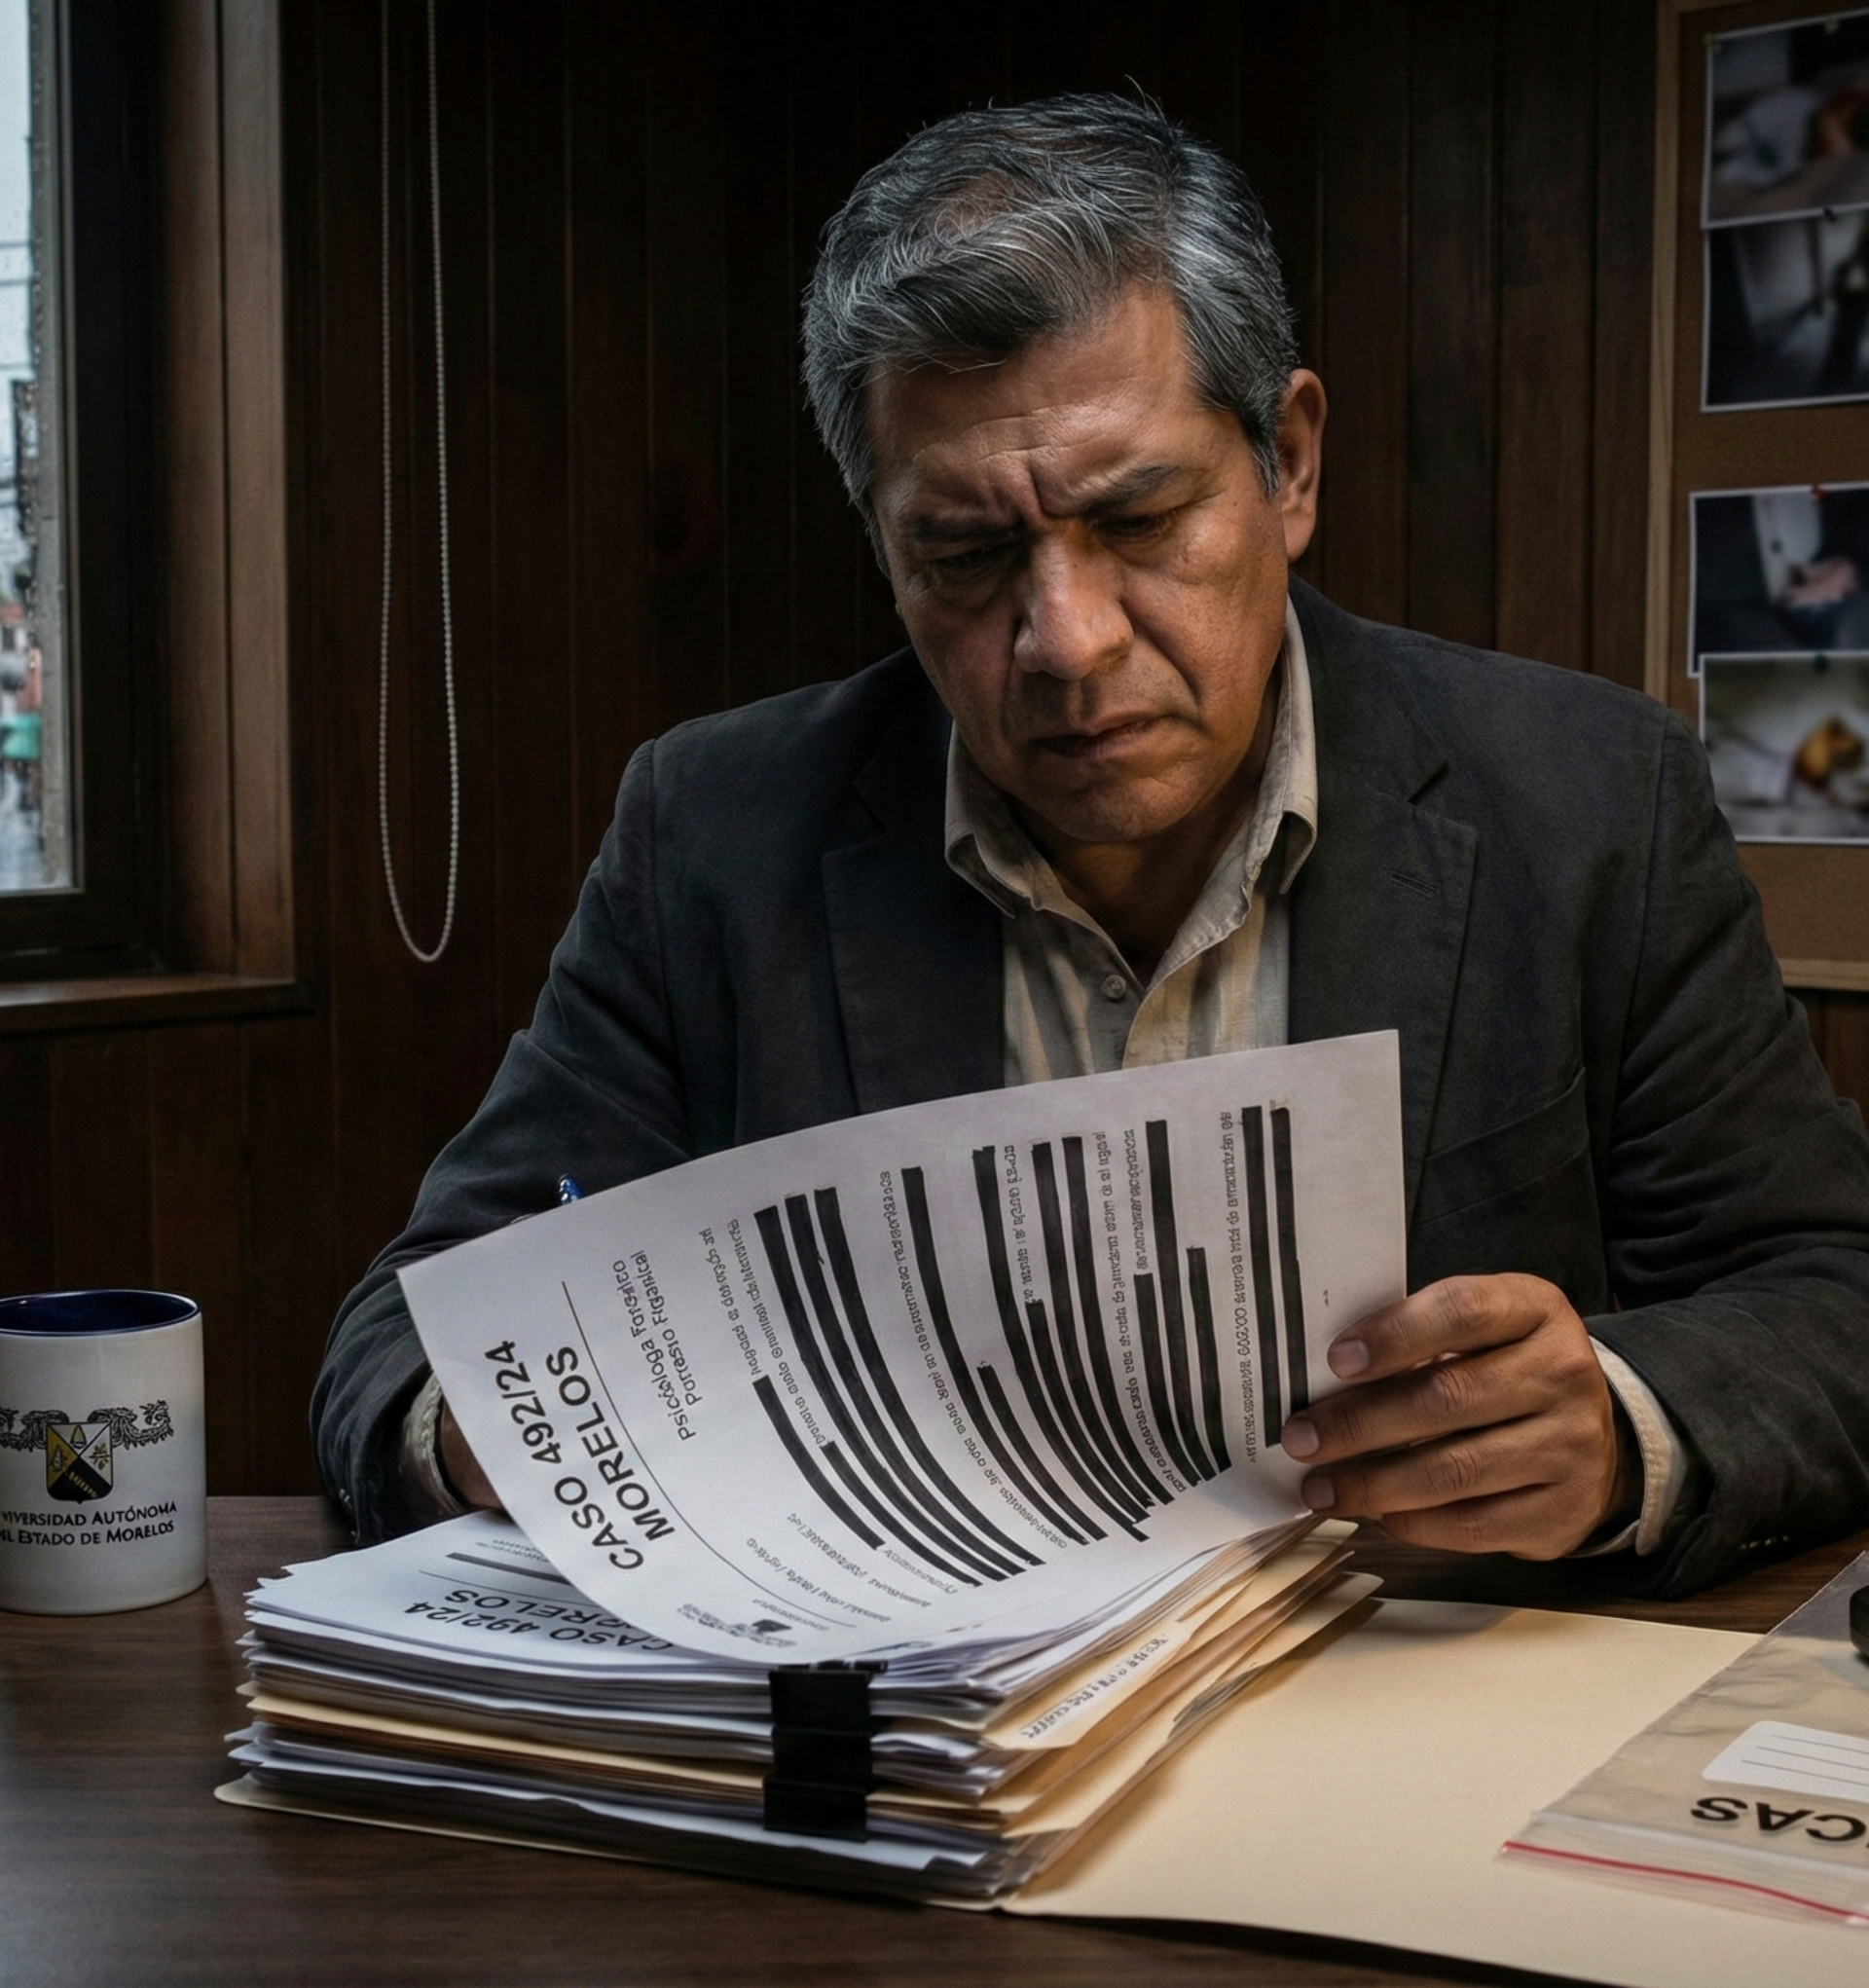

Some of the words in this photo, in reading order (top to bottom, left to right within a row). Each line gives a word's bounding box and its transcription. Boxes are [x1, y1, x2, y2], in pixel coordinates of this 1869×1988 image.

[484, 1340, 562, 1464] 492/24
[546, 1346, 676, 1541] MORELOS
[81, 1532, 101, 1545] DE
[554, 1476, 643, 1570] CASO
[404, 1601, 540, 1634] 492/24
[549, 1627, 673, 1651] CASO
